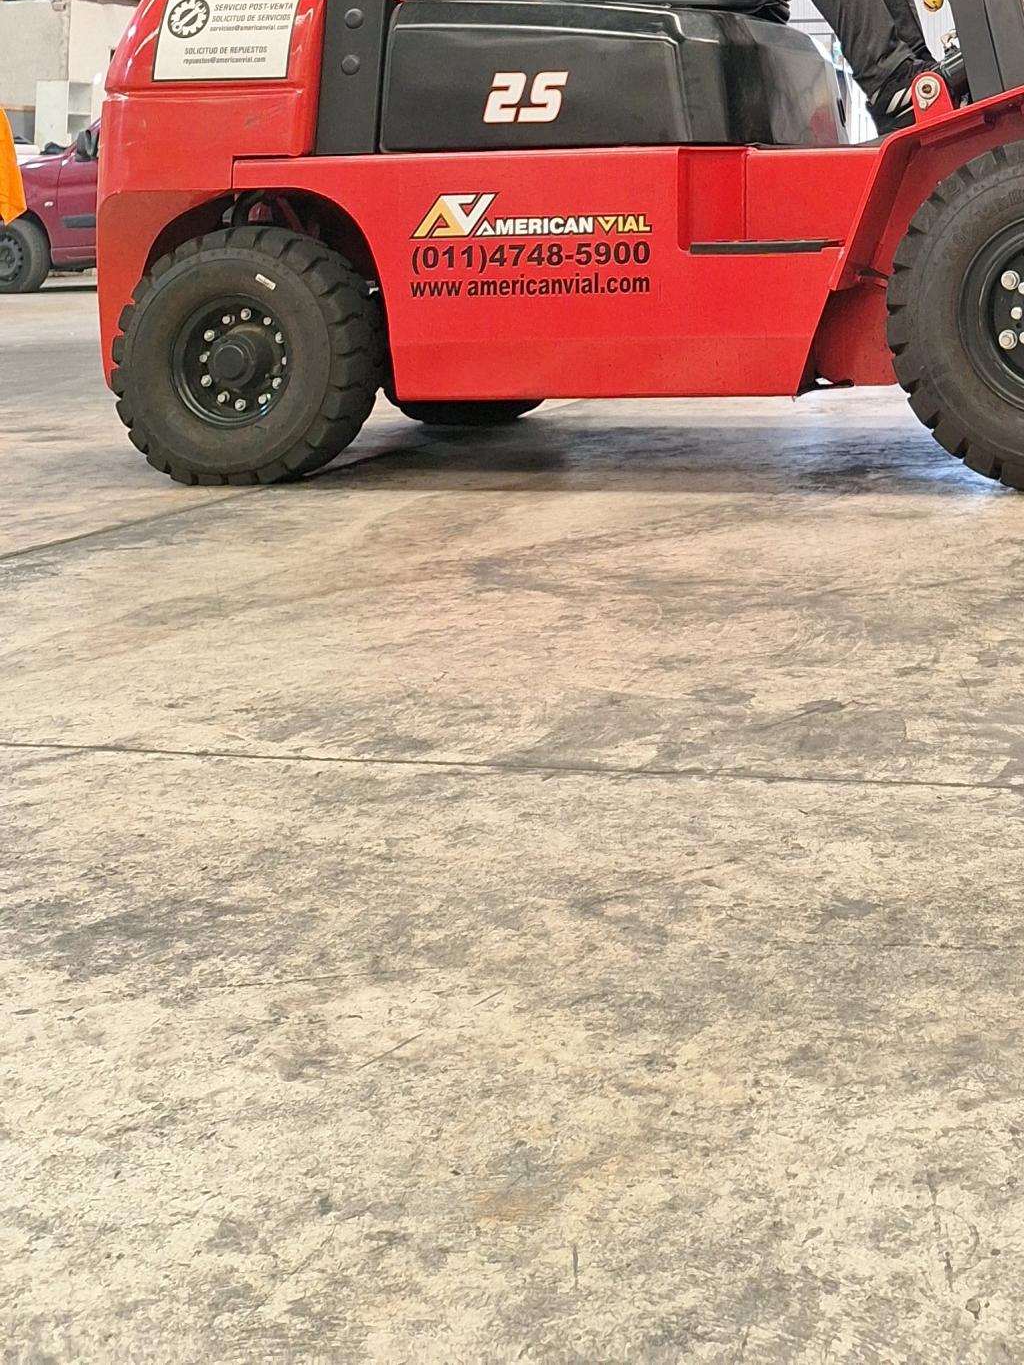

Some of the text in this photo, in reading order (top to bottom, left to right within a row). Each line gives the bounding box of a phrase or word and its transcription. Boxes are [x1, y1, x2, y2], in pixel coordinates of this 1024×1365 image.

[213, 2, 294, 12] SERVICIO POST-VENTA
[211, 13, 291, 23] SOLICITUD DE SERVICIOS
[184, 45, 268, 55] SOLICITUD DE REPUESTOS
[482, 70, 569, 124] 25
[475, 213, 652, 237] AMERICAN VIAL
[411, 240, 650, 275] (011)4748-5900
